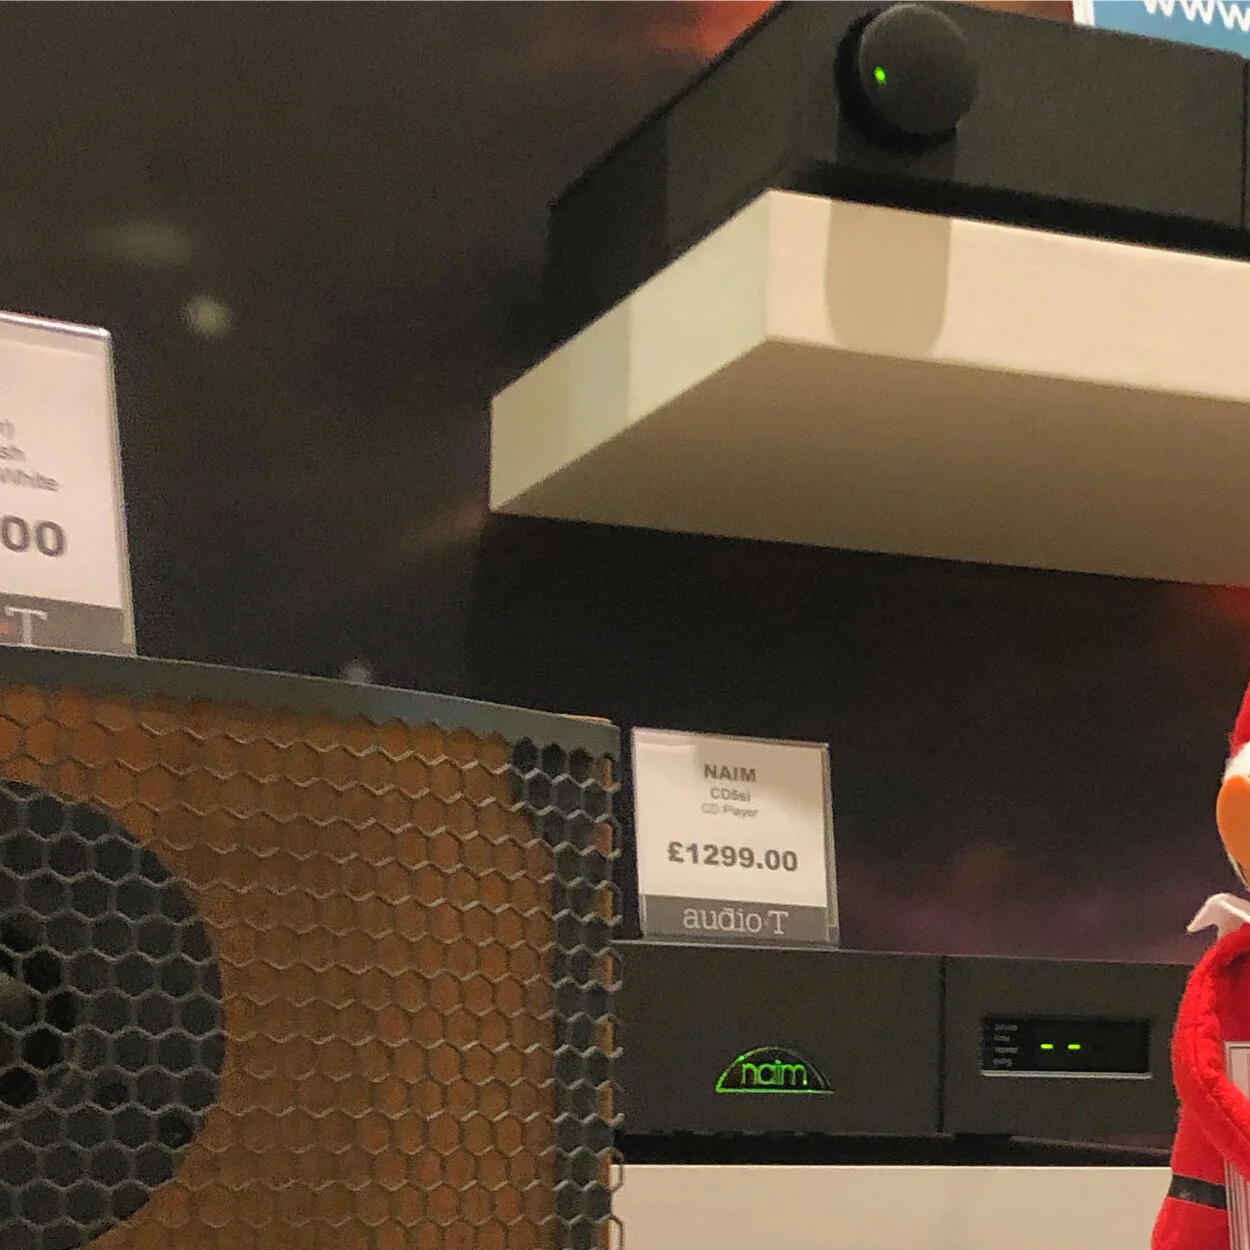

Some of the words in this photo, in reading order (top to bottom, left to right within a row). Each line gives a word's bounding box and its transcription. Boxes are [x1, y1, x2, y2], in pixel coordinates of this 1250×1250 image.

[703, 763, 757, 783] NAIM
[701, 803, 719, 815] CD
[667, 840, 798, 872] £1299.00
[741, 1059, 809, 1086] naim
